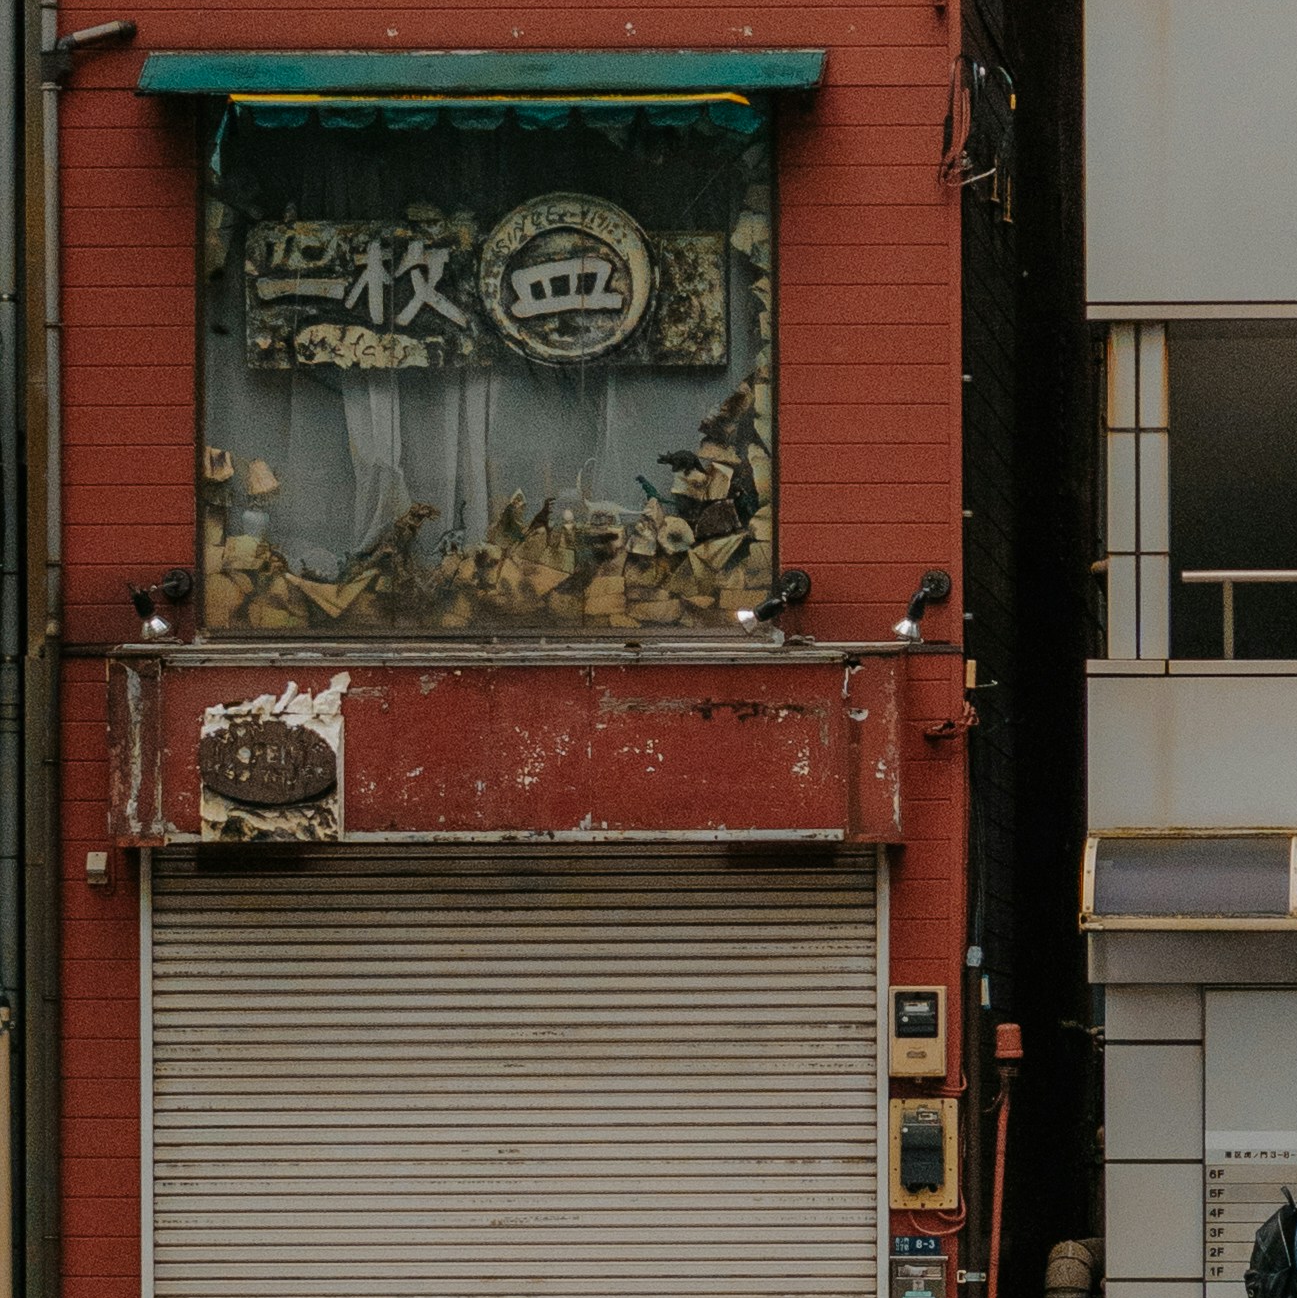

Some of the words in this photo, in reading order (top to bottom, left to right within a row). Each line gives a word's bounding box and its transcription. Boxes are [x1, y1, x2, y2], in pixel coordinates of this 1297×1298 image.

[1209, 1169, 1225, 1179] 6F
[1209, 1188, 1225, 1199] 5F
[1209, 1208, 1225, 1218] 4F
[1209, 1228, 1225, 1237] 3F
[916, 1239, 935, 1249] 8-3
[1209, 1247, 1225, 1257] 2F
[1209, 1267, 1225, 1276] 1F
